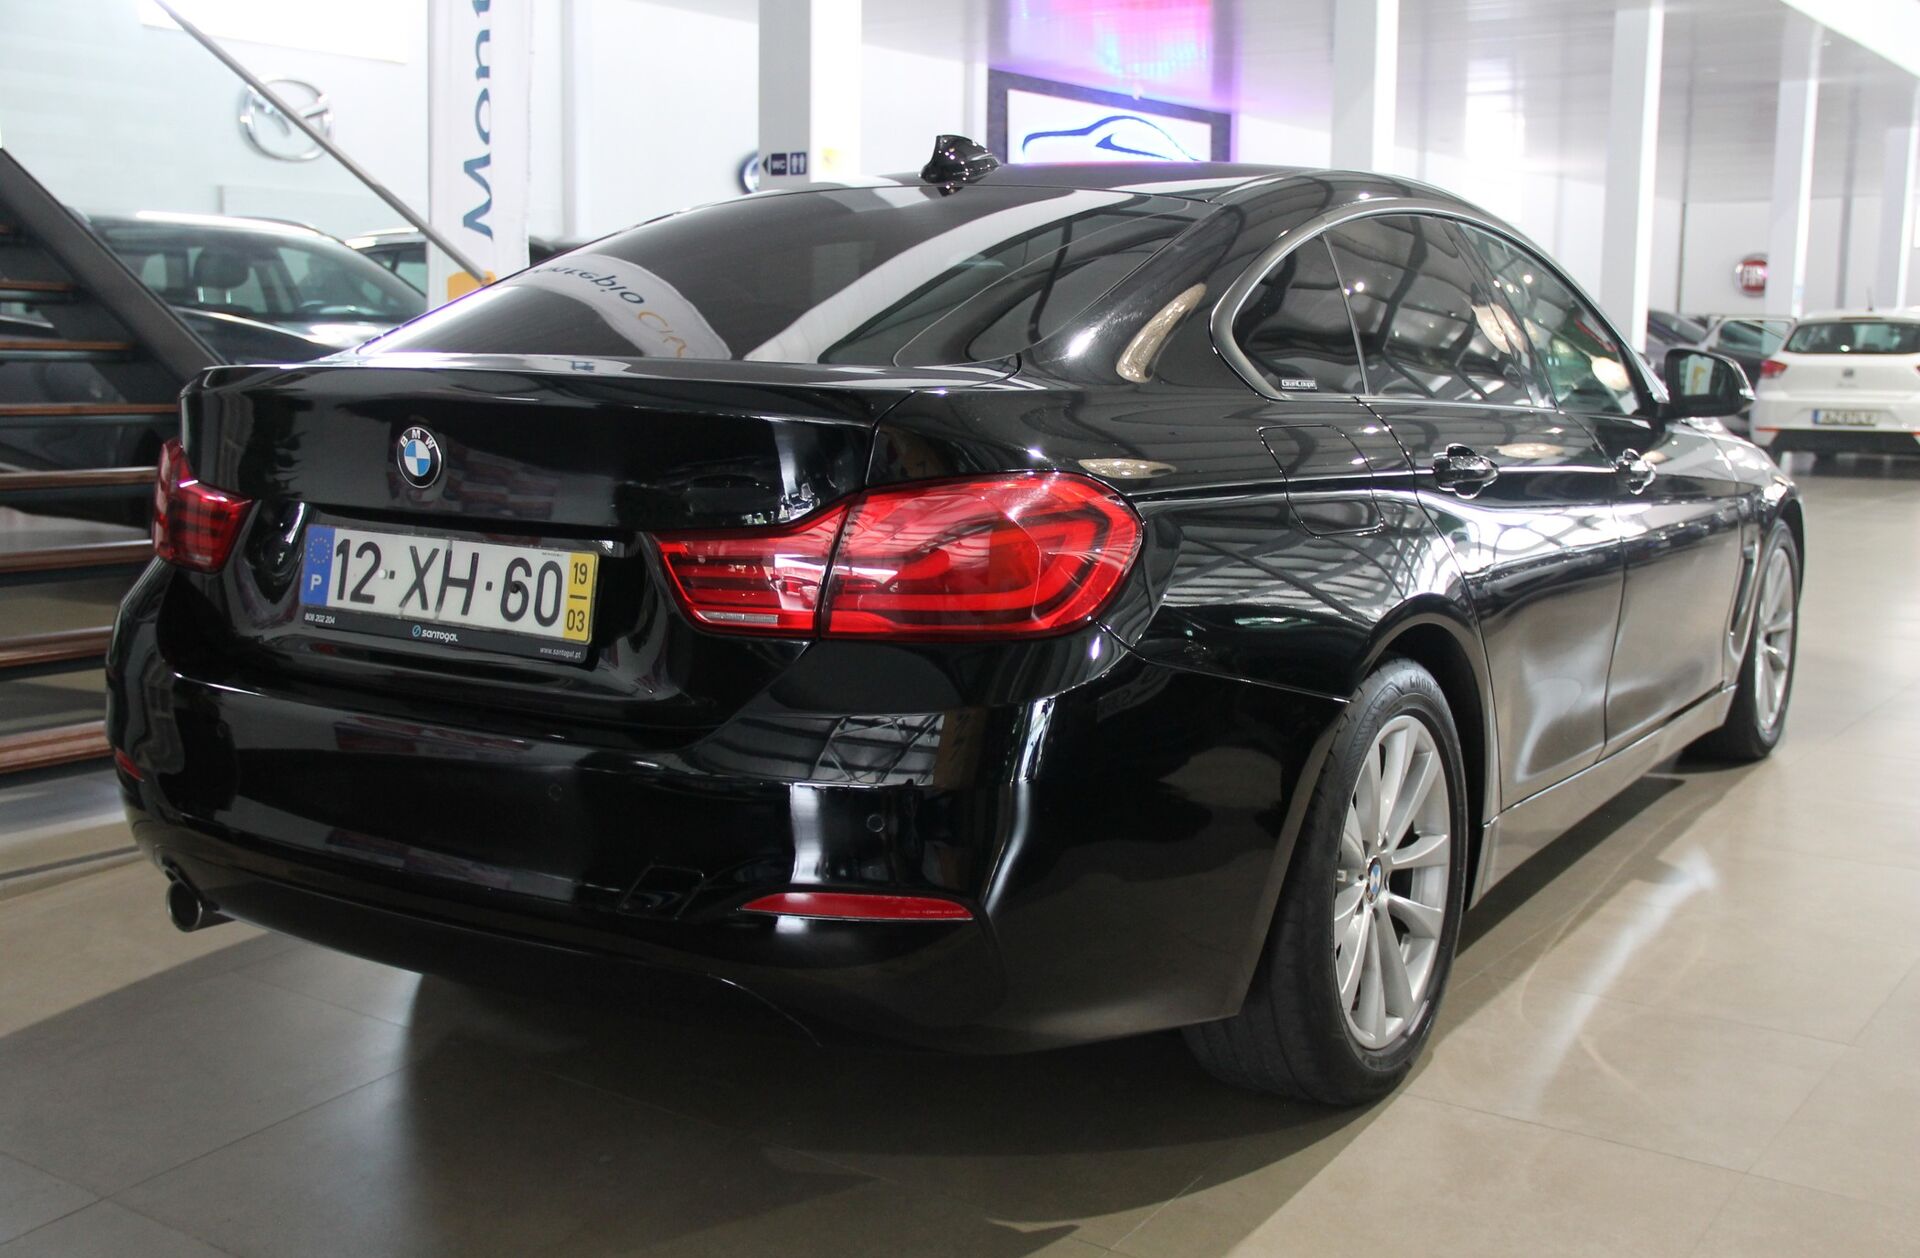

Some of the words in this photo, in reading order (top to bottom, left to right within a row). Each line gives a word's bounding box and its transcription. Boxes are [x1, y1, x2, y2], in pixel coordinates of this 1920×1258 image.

[772, 161, 786, 170] WC
[400, 429, 436, 450] BMW
[310, 574, 322, 591] P
[573, 562, 588, 585] 19
[566, 609, 585, 632] 03
[539, 647, 582, 659] www.santogal.pt
